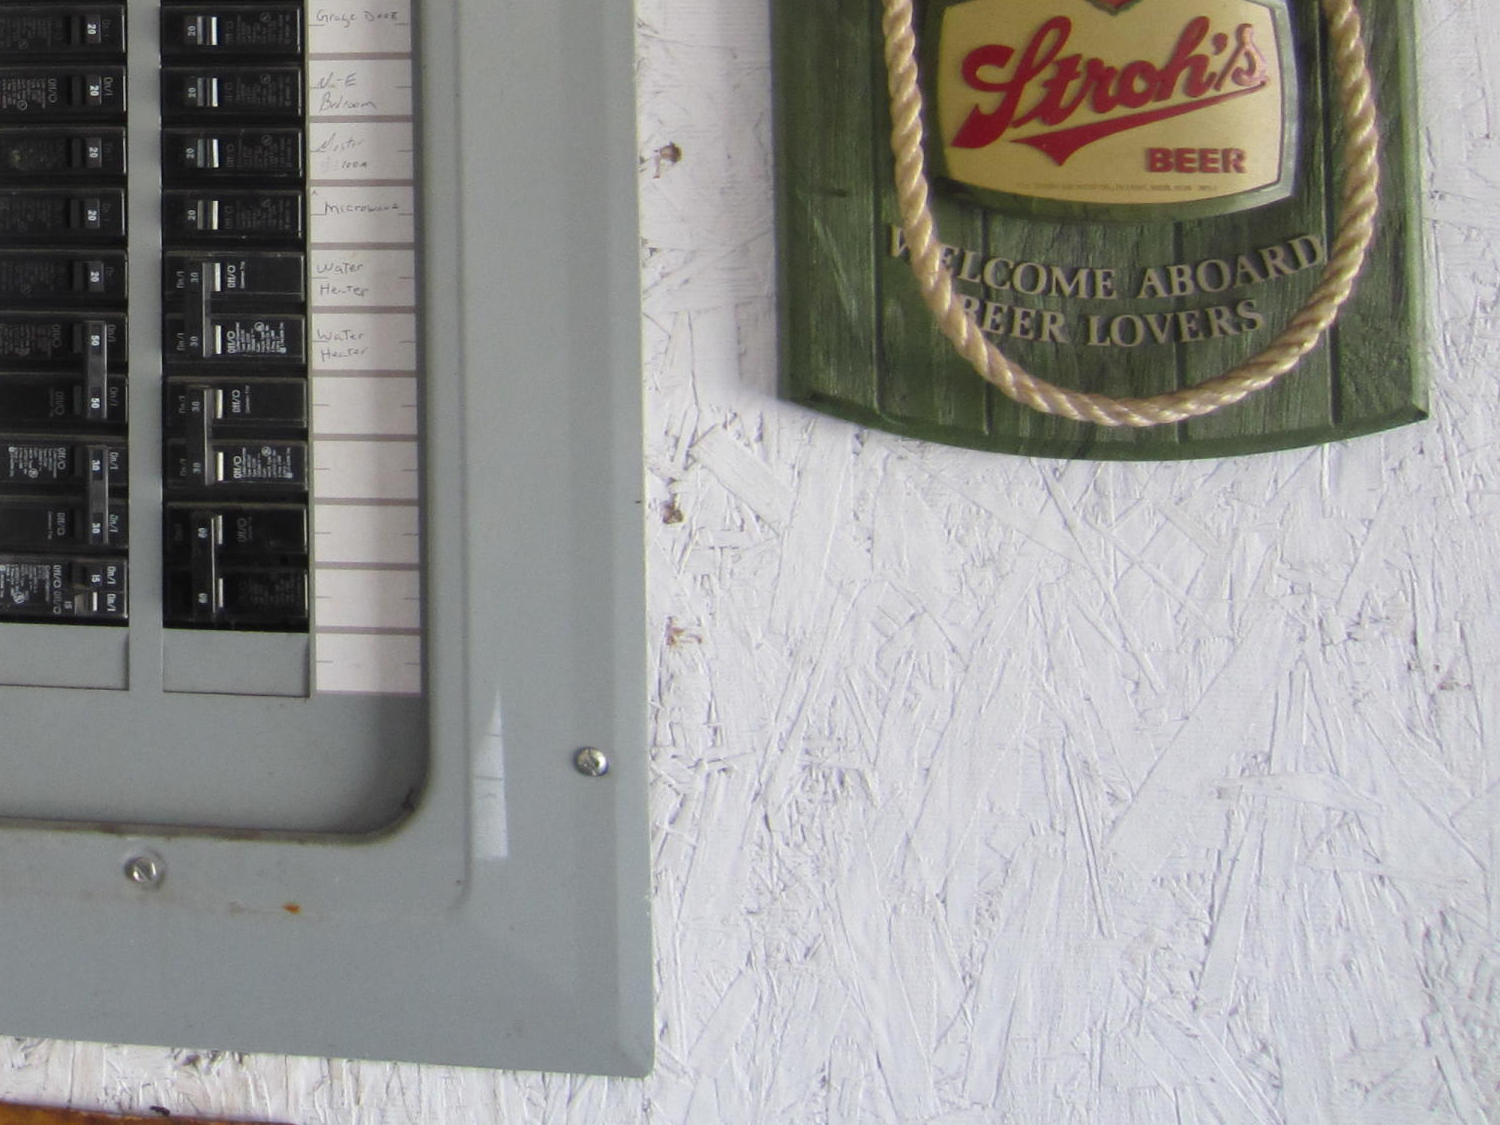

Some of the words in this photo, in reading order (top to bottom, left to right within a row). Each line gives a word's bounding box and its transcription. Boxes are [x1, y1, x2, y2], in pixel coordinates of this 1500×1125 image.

[87, 23, 97, 35] 20
[951, 15, 1268, 150] Stroh's
[89, 85, 99, 96] 20
[89, 147, 98, 158] 20
[1145, 147, 1246, 174] BEER
[87, 210, 97, 221] 20
[1139, 233, 1329, 301] ABOARD
[90, 271, 100, 282] 20
[1086, 298, 1266, 348] LOVERS
[90, 335, 100, 346] 50
[91, 397, 100, 409] 50
